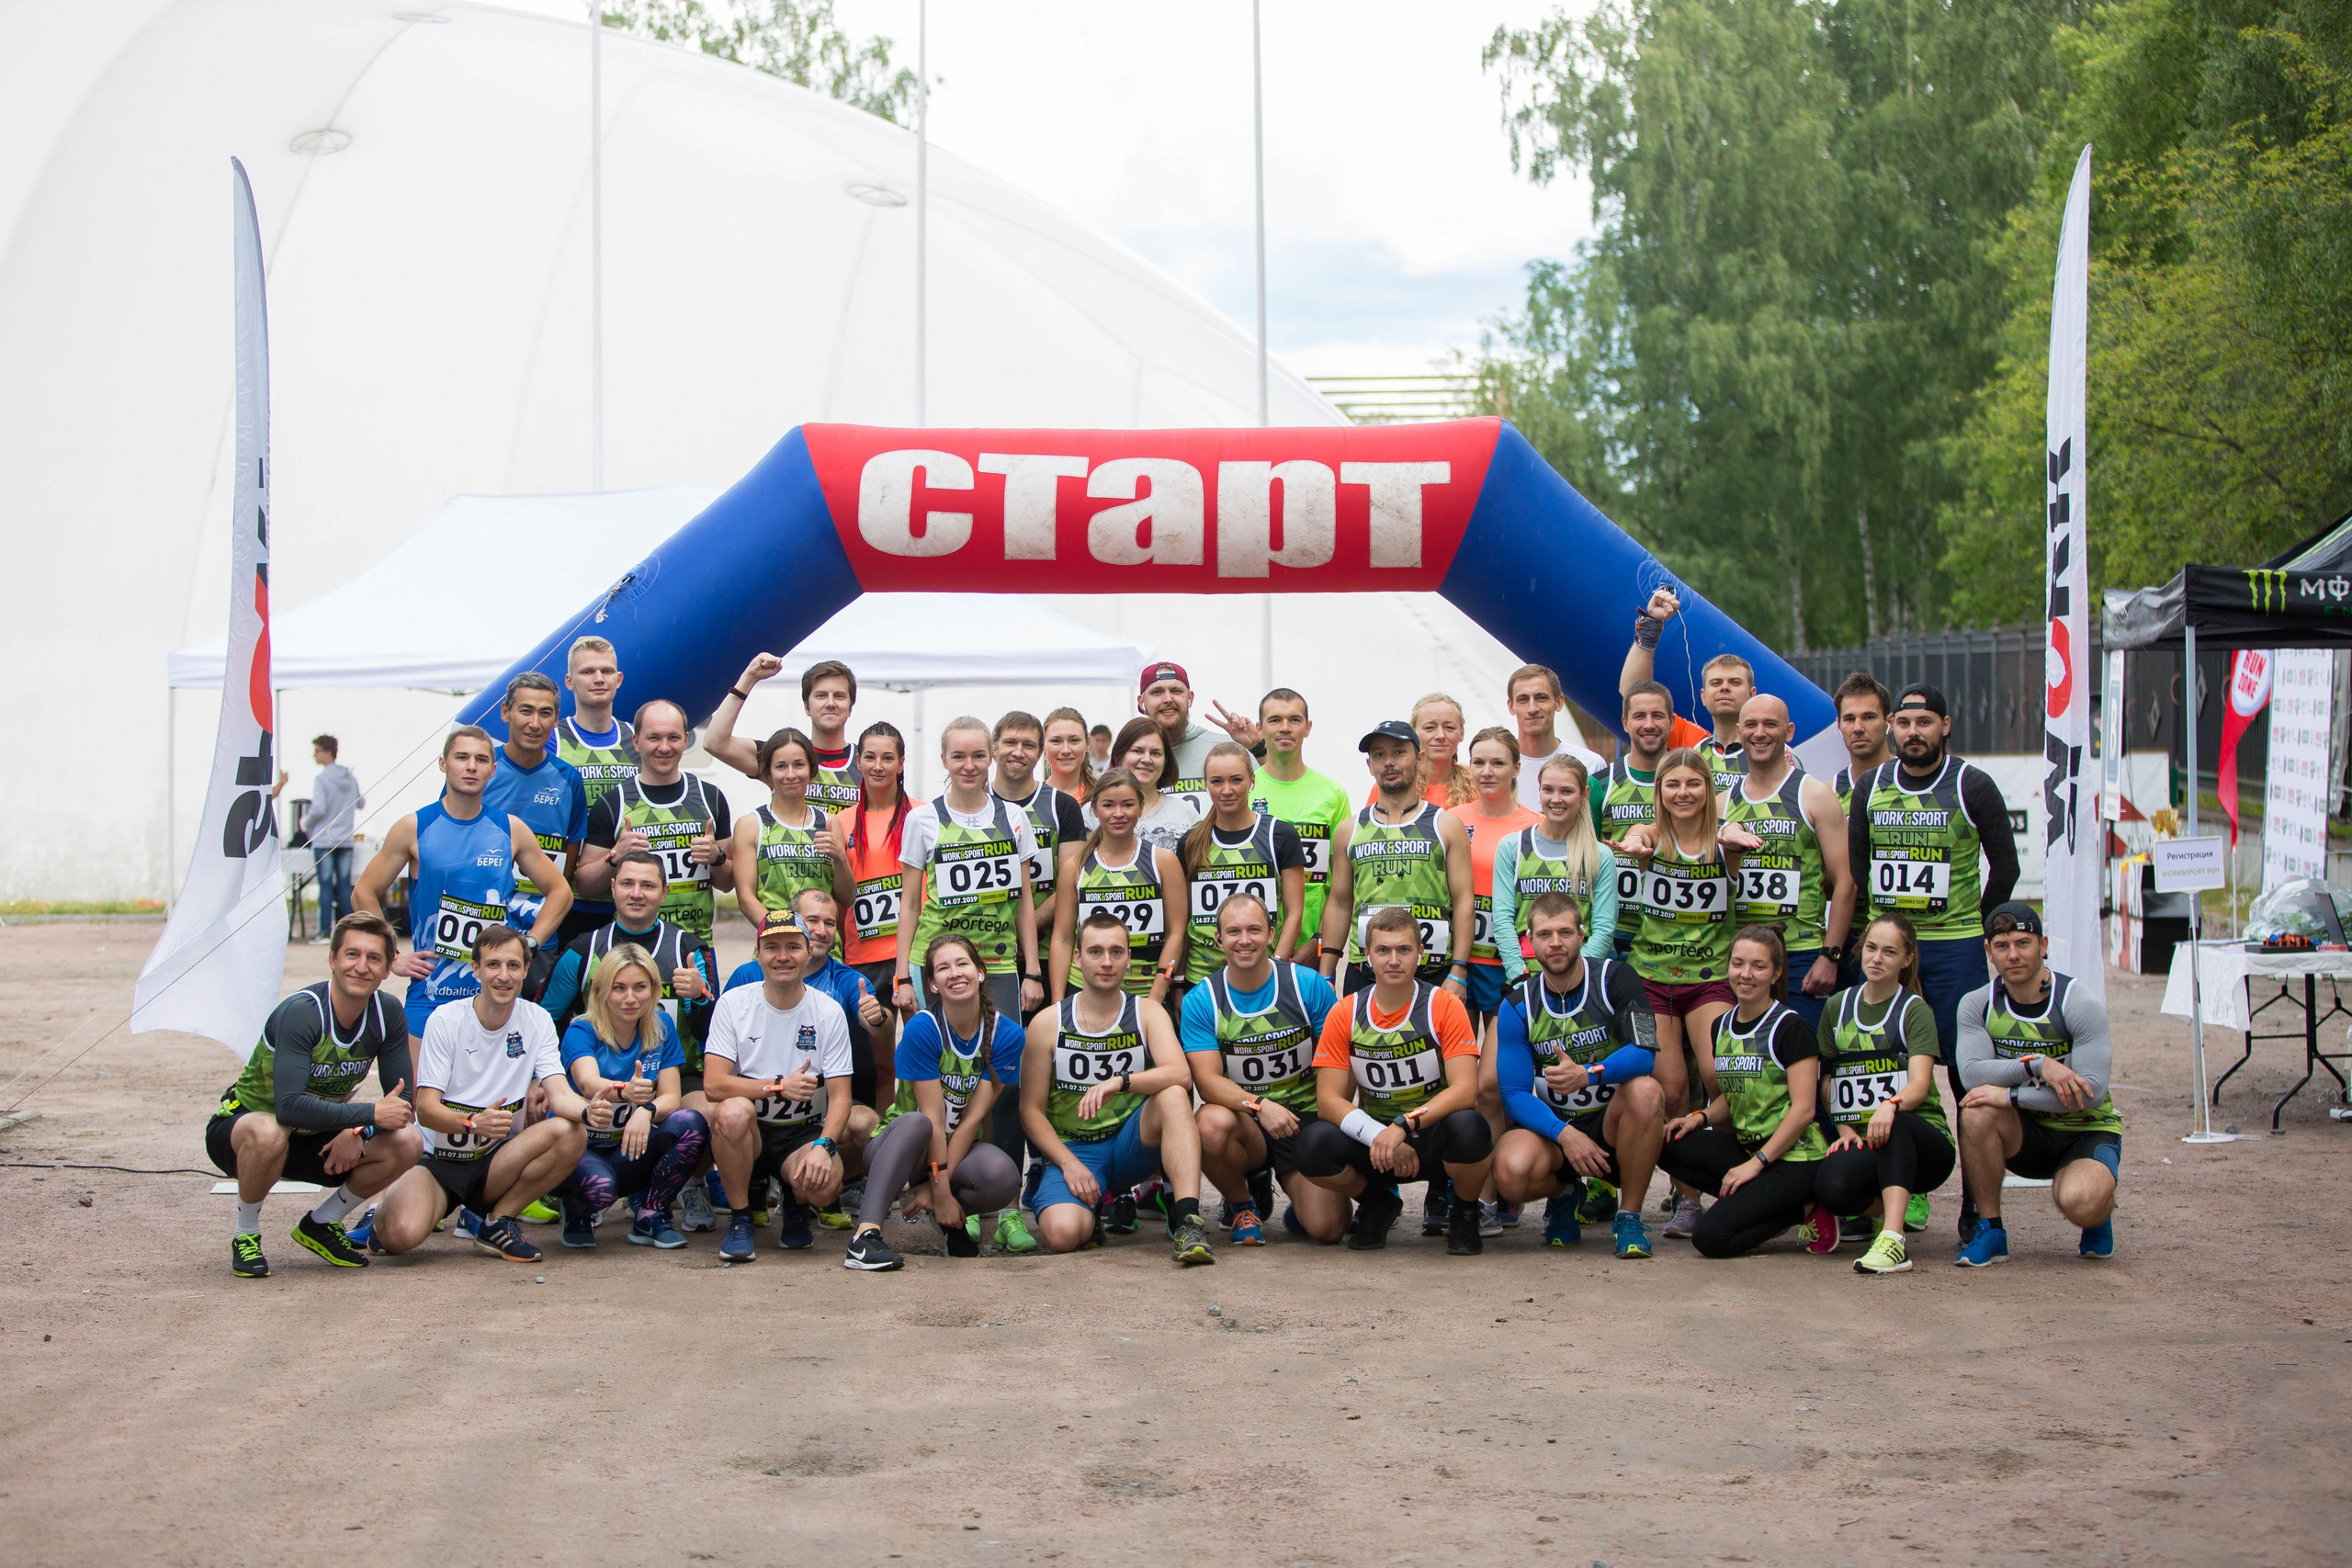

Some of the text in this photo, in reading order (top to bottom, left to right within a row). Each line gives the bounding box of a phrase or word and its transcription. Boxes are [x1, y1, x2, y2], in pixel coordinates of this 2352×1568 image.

[2244, 649, 2267, 680] RUN
[2237, 672, 2259, 700] ZONE
[1174, 779, 1205, 792] RUN
[534, 794, 560, 806] БЕРЕГ
[1873, 811, 1949, 826] WORK&SPORT
[1294, 825, 1324, 838] RUN
[1889, 832, 1928, 846] RUN
[766, 843, 833, 860] WORK&SP
[942, 841, 1012, 862] WORK&SPORT RUN
[1355, 840, 1431, 859] WORK&SPORT
[1876, 847, 1943, 862] WORK&SPORT RUN
[2166, 850, 2213, 861] Регистрация
[477, 858, 503, 867] БЕРЕГ
[667, 851, 698, 879] 19
[1373, 860, 1411, 876] RUN
[1761, 855, 1793, 869] RUN
[786, 863, 822, 879] RUN
[950, 859, 1012, 892] 025
[1198, 864, 1268, 880] WORK&SPORT RUN
[1653, 863, 1720, 878] WORK&SPORT RUN
[1880, 863, 1935, 894] 014
[882, 874, 902, 890] RU
[1521, 878, 1589, 896] WORK&SPR
[944, 896, 978, 906] 14.07.2019
[1085, 886, 1156, 902] WORK&SPORT RUN
[1653, 877, 1717, 909] 039
[441, 899, 506, 919] WORK&SPORT RUN
[1411, 905, 1442, 919] RUN
[1645, 907, 1676, 919] 14.07.2019
[438, 915, 502, 948] 00
[1648, 942, 1713, 960] sportego
[1065, 1033, 1136, 1051] WORK&SPORT RUN
[1234, 1029, 1306, 1055] WORK&SPORT RUN
[1354, 1038, 1427, 1059] WORK&SPORT RUN
[1069, 1052, 1134, 1081] 032
[1242, 1048, 1302, 1082] 031
[1865, 1058, 1898, 1074] RUN
[1365, 1058, 1425, 1089] 011
[1061, 1083, 1091, 1091] 14.07.201
[1721, 1077, 1745, 1094] RUN
[1838, 1076, 1896, 1109] 033
[1834, 1113, 1860, 1122] 14.07.2019
[438, 1150, 474, 1159] 14.07.2019
